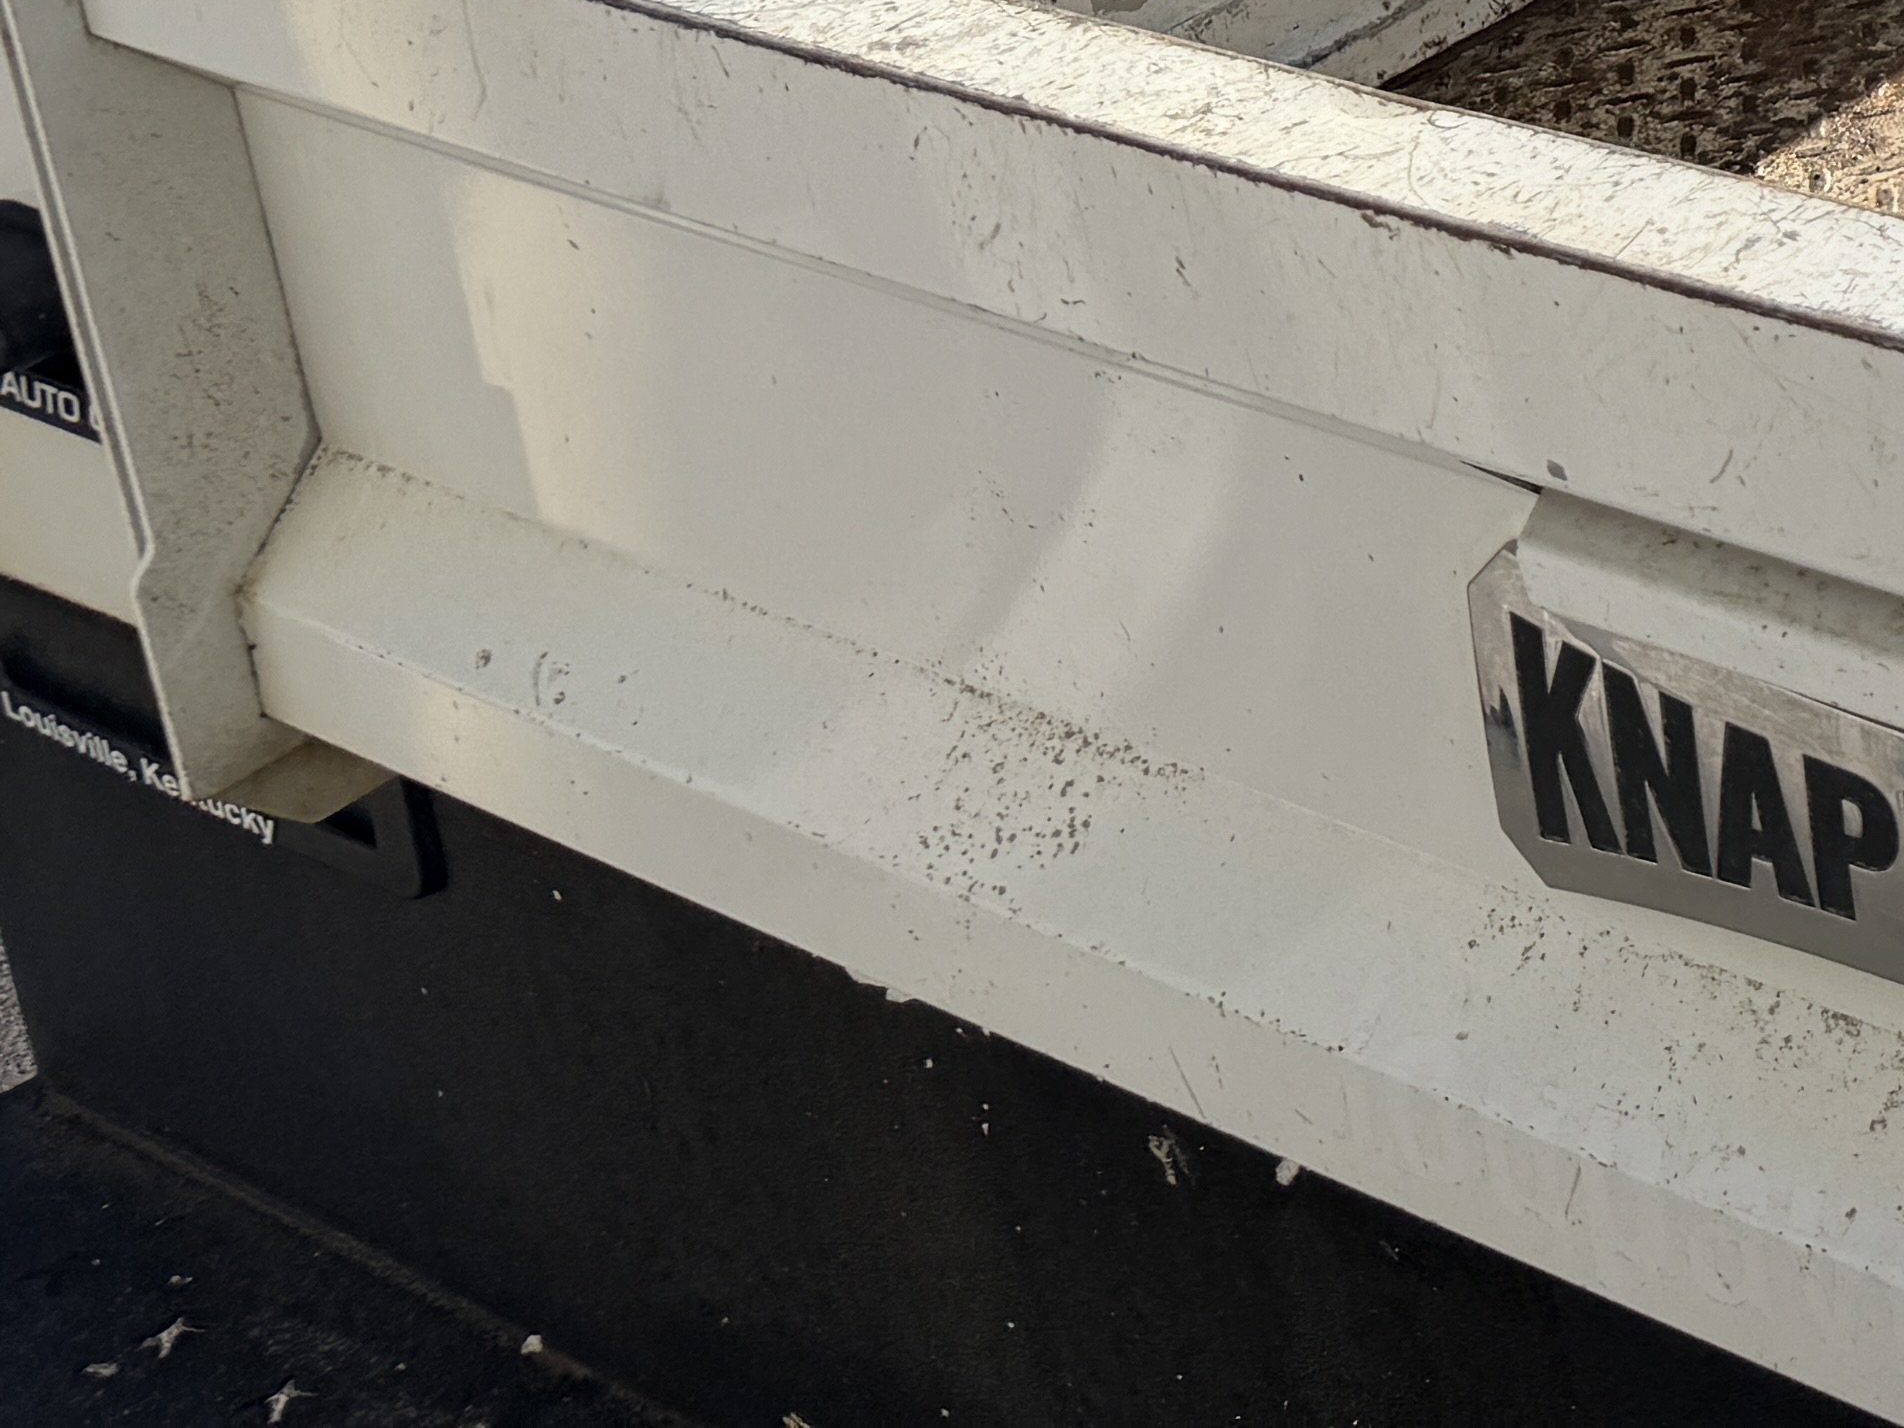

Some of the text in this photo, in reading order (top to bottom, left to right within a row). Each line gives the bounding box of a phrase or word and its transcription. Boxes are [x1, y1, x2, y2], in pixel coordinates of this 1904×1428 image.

[0, 371, 80, 423] AUTO
[0, 690, 275, 844] Louisville, Keucky
